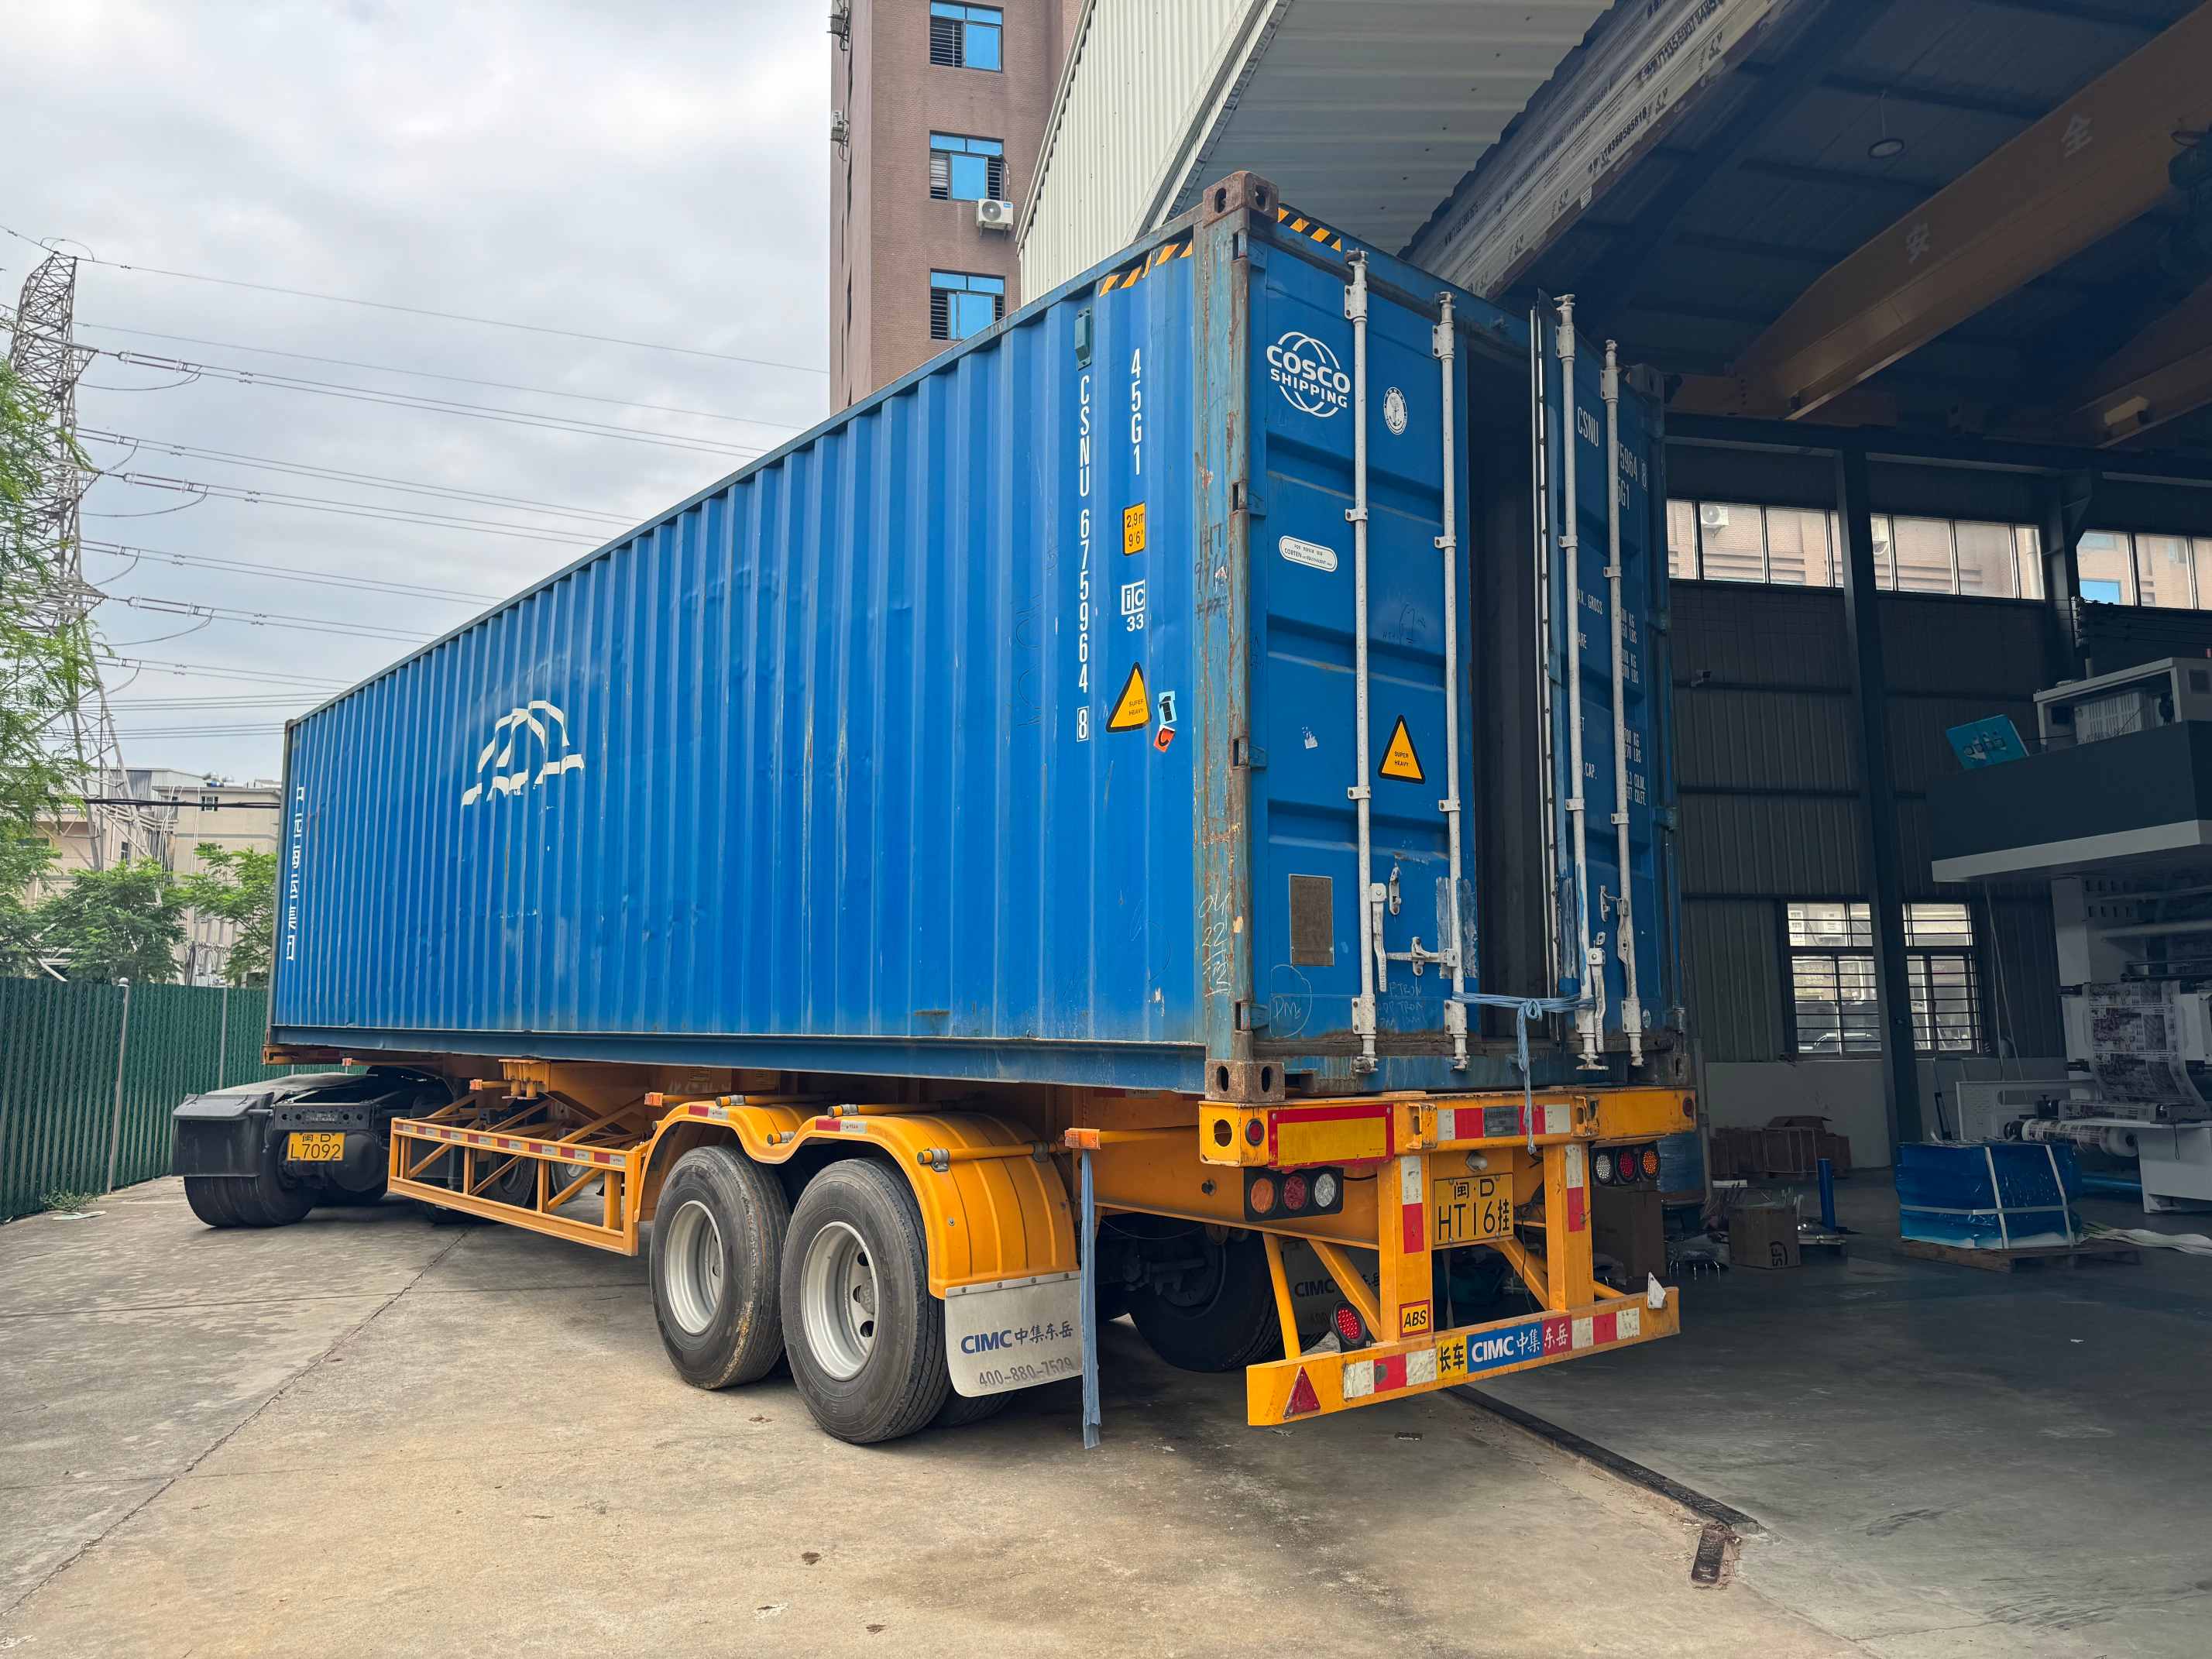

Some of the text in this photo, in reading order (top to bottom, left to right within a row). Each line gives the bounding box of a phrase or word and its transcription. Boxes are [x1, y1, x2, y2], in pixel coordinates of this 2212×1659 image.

[1266, 345, 1351, 393] COSCO
[1270, 368, 1348, 408] SHIPPING
[1132, 349, 1142, 475] 45G1
[1577, 406, 1599, 447] CSNU
[1077, 376, 1091, 742] CSNU 675964 8
[1284, 548, 1302, 558] CORTEN
[1588, 594, 1603, 615] GROSS
[1126, 613, 1144, 632] 33
[1128, 699, 1144, 707] SUPER
[1394, 750, 1409, 759] SUPER
[1394, 759, 1409, 768] HEAVY
[290, 1143, 341, 1159] L7092
[1438, 1198, 1510, 1240] HT16挂
[1294, 1279, 1335, 1298] CIMC
[1403, 1308, 1427, 1328] ABS
[960, 1321, 1073, 1354] CIMC 中集东岳
[1439, 1323, 1568, 1373] 长车 CIMC 中集东岳
[979, 1357, 1073, 1388] 400-880-7529
